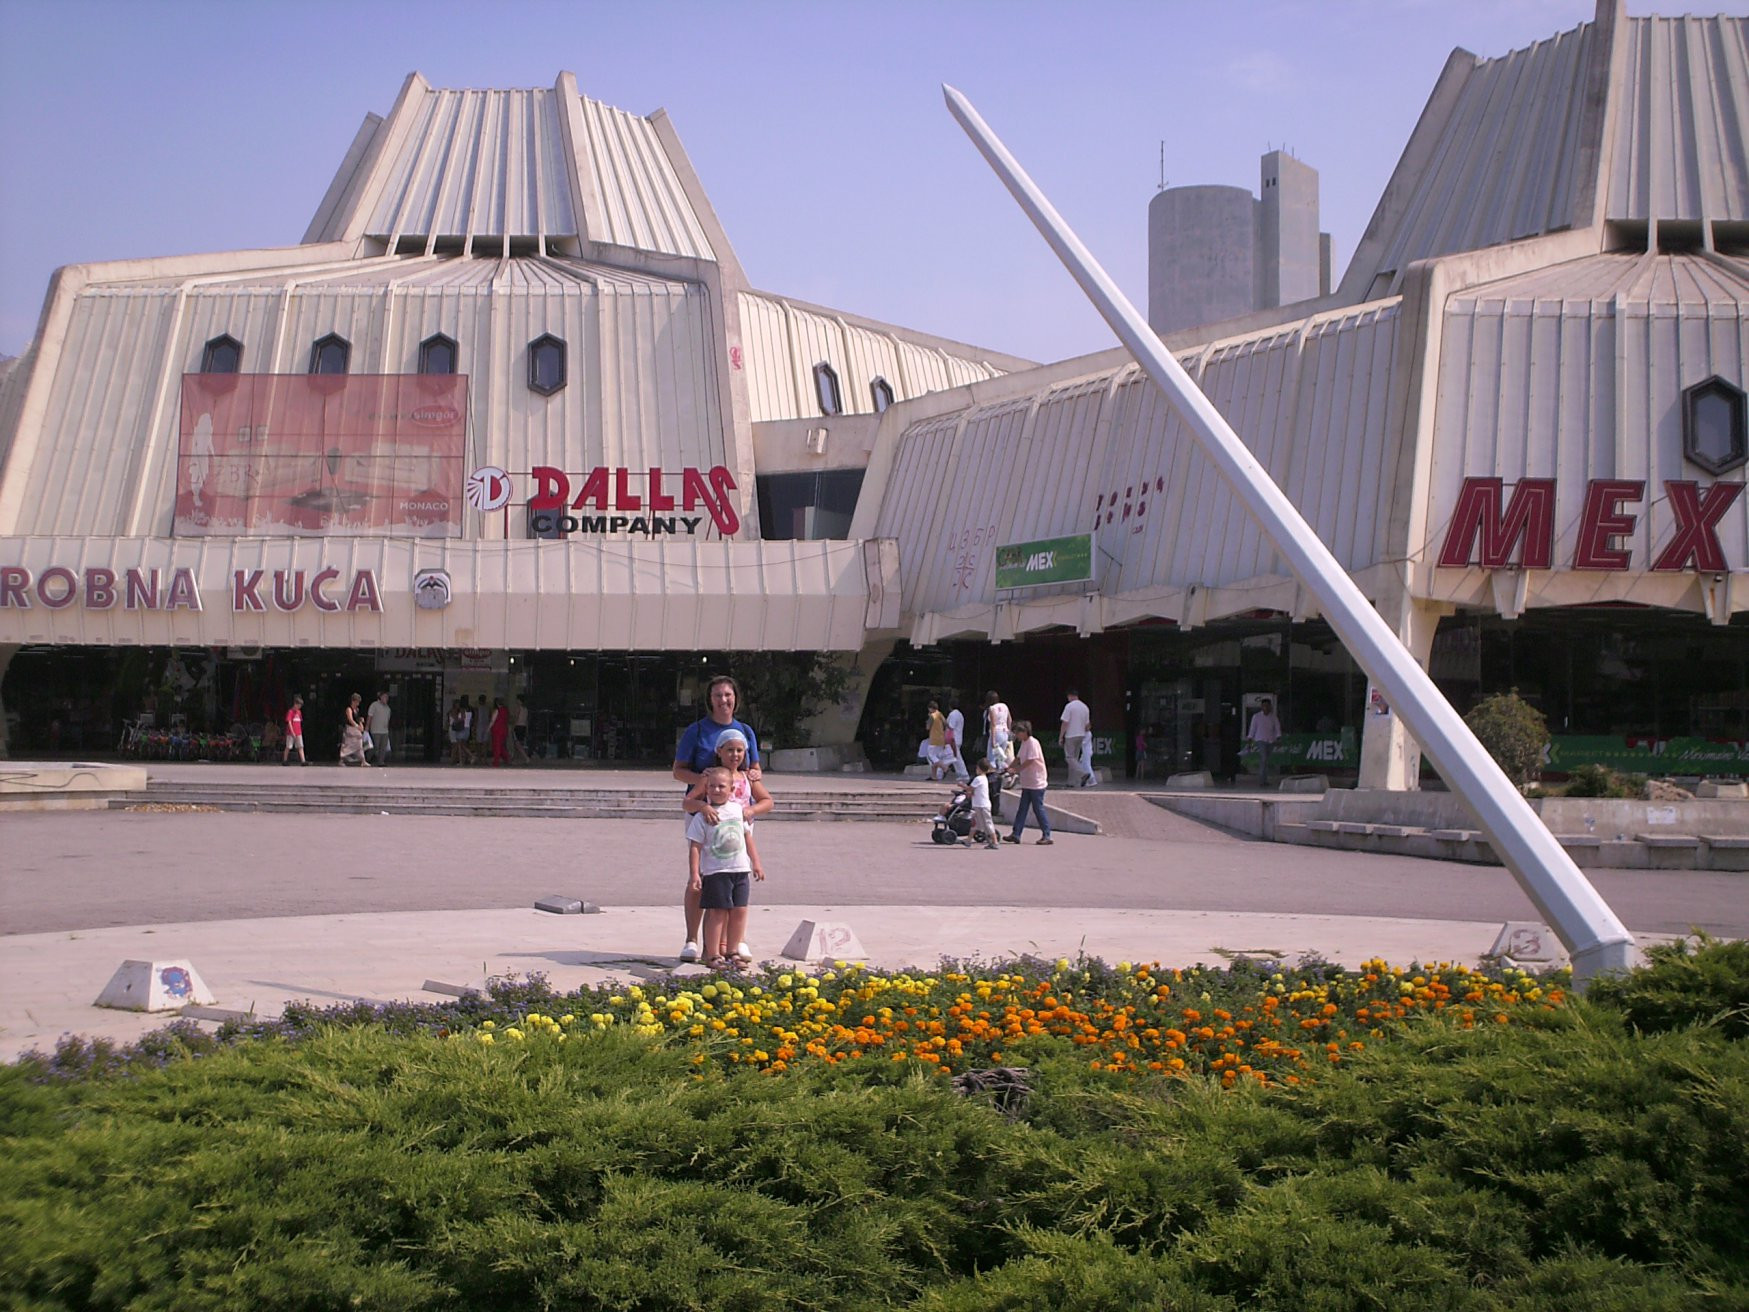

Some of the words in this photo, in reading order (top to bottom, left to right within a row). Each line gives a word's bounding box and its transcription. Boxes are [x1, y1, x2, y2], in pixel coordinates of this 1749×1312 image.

[400, 502, 448, 510] MONACO
[531, 465, 740, 535] DALLAS
[531, 515, 703, 535] COMPANY
[1437, 476, 1747, 572] MEX
[1025, 550, 1054, 572] MEX
[0, 566, 204, 612] ROBNA
[232, 565, 385, 613] KUĆA
[1306, 740, 1344, 760] MEX
[816, 927, 852, 954] 12
